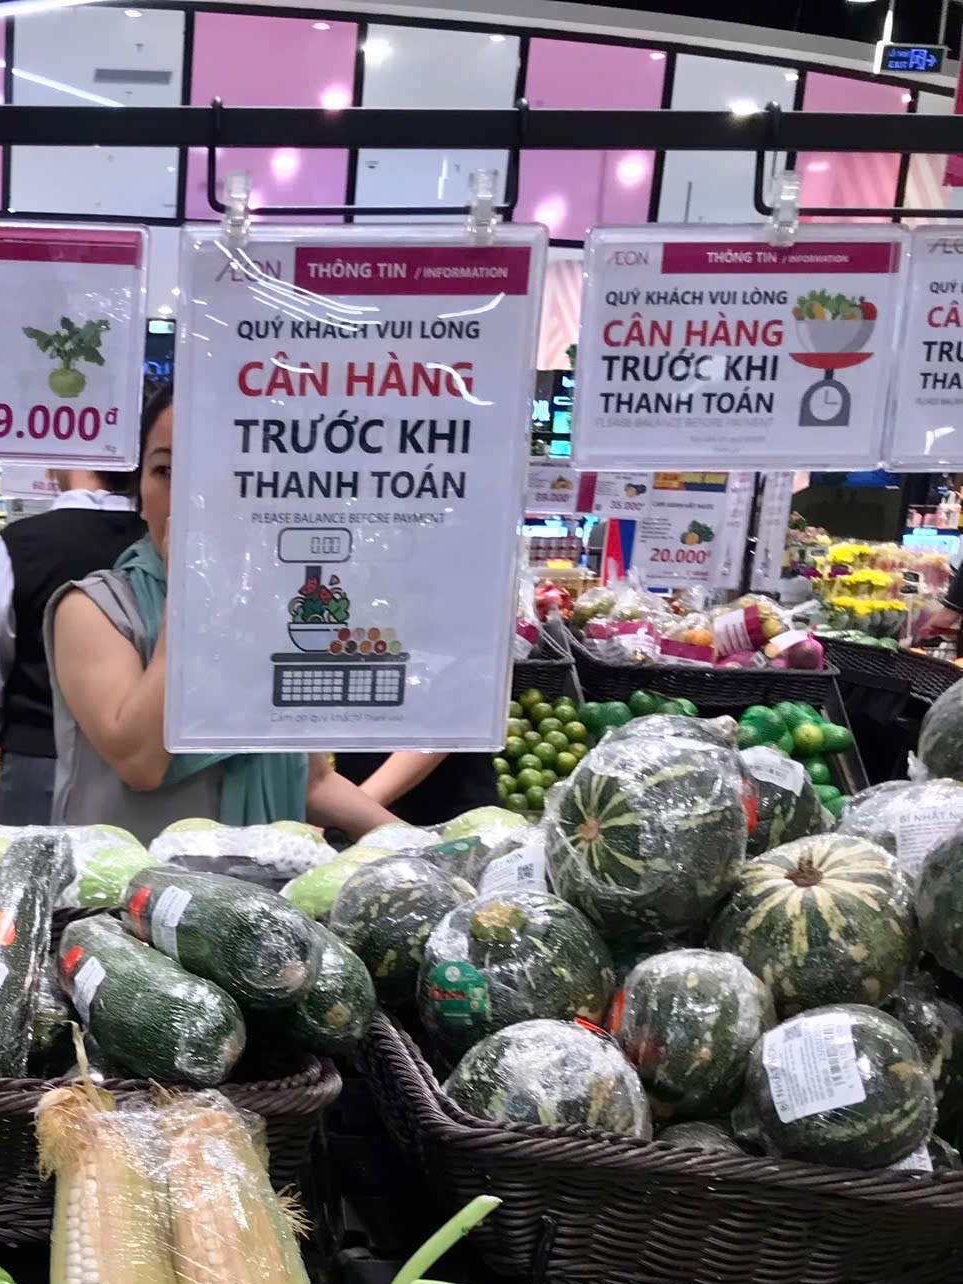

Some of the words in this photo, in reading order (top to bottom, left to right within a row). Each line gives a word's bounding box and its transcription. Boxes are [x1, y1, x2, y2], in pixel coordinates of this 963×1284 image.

[308, 258, 372, 279] THÔNG
[376, 263, 407, 279] TIN
[706, 249, 753, 263] THÔNG
[756, 252, 778, 263] TIN
[605, 287, 640, 307] QUÝ
[645, 287, 704, 306] KHÁCH
[709, 291, 737, 306] VUI
[742, 287, 789, 306] LÒNG
[929, 280, 958, 294] QUÝ
[237, 314, 284, 341] QUÝ
[290, 316, 368, 339] KHÁCH
[376, 320, 412, 339] VUI
[421, 316, 480, 340] LÒNG
[604, 312, 673, 347] CÂN
[686, 312, 784, 347] HÀNG
[237, 351, 329, 397] CÂN
[345, 352, 474, 398] HÀNG
[601, 349, 715, 382] TRƯỚC
[725, 355, 779, 382] KHI
[600, 392, 694, 414] THANH
[702, 387, 775, 414] TOÁN
[234, 410, 385, 454] TRƯỚC
[399, 419, 471, 454] KHI
[234, 470, 359, 499] THANH
[370, 463, 466, 499] TOÁN
[293, 513, 346, 524] BALANCE
